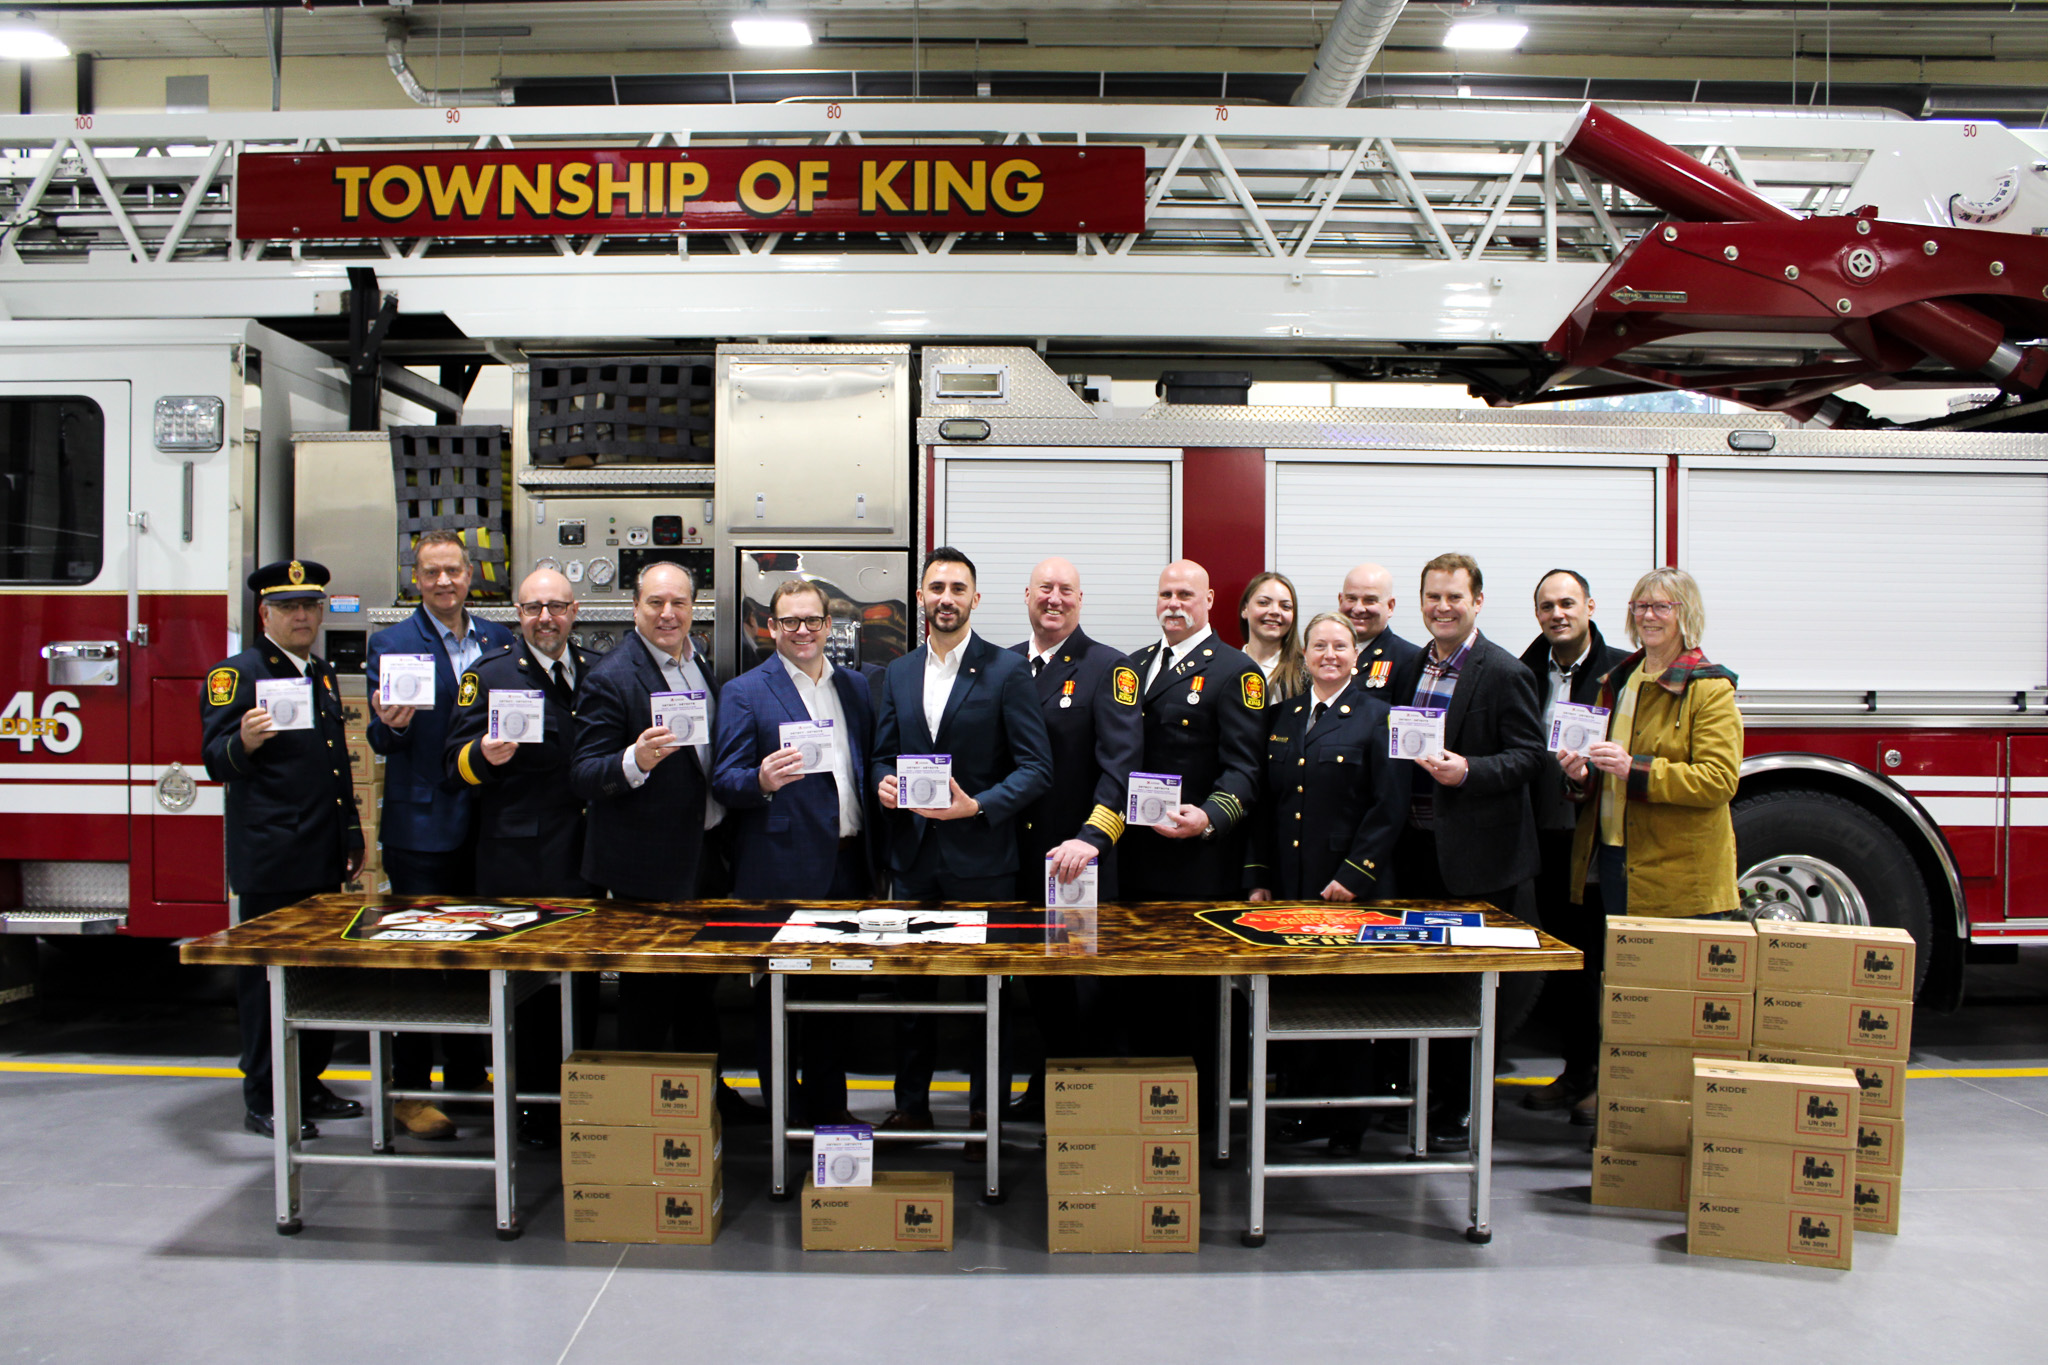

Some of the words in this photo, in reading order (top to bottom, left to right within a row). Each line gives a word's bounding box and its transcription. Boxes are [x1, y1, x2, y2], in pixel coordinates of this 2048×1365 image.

[446, 110, 460, 123] 90
[827, 105, 842, 119] 80
[1215, 107, 1229, 121] 70
[75, 116, 92, 130] 100
[1963, 124, 1977, 138] 50
[334, 162, 710, 219] TOWNSHIP
[739, 160, 829, 214] OF
[862, 159, 1044, 213] KING
[0, 691, 82, 753] 46
